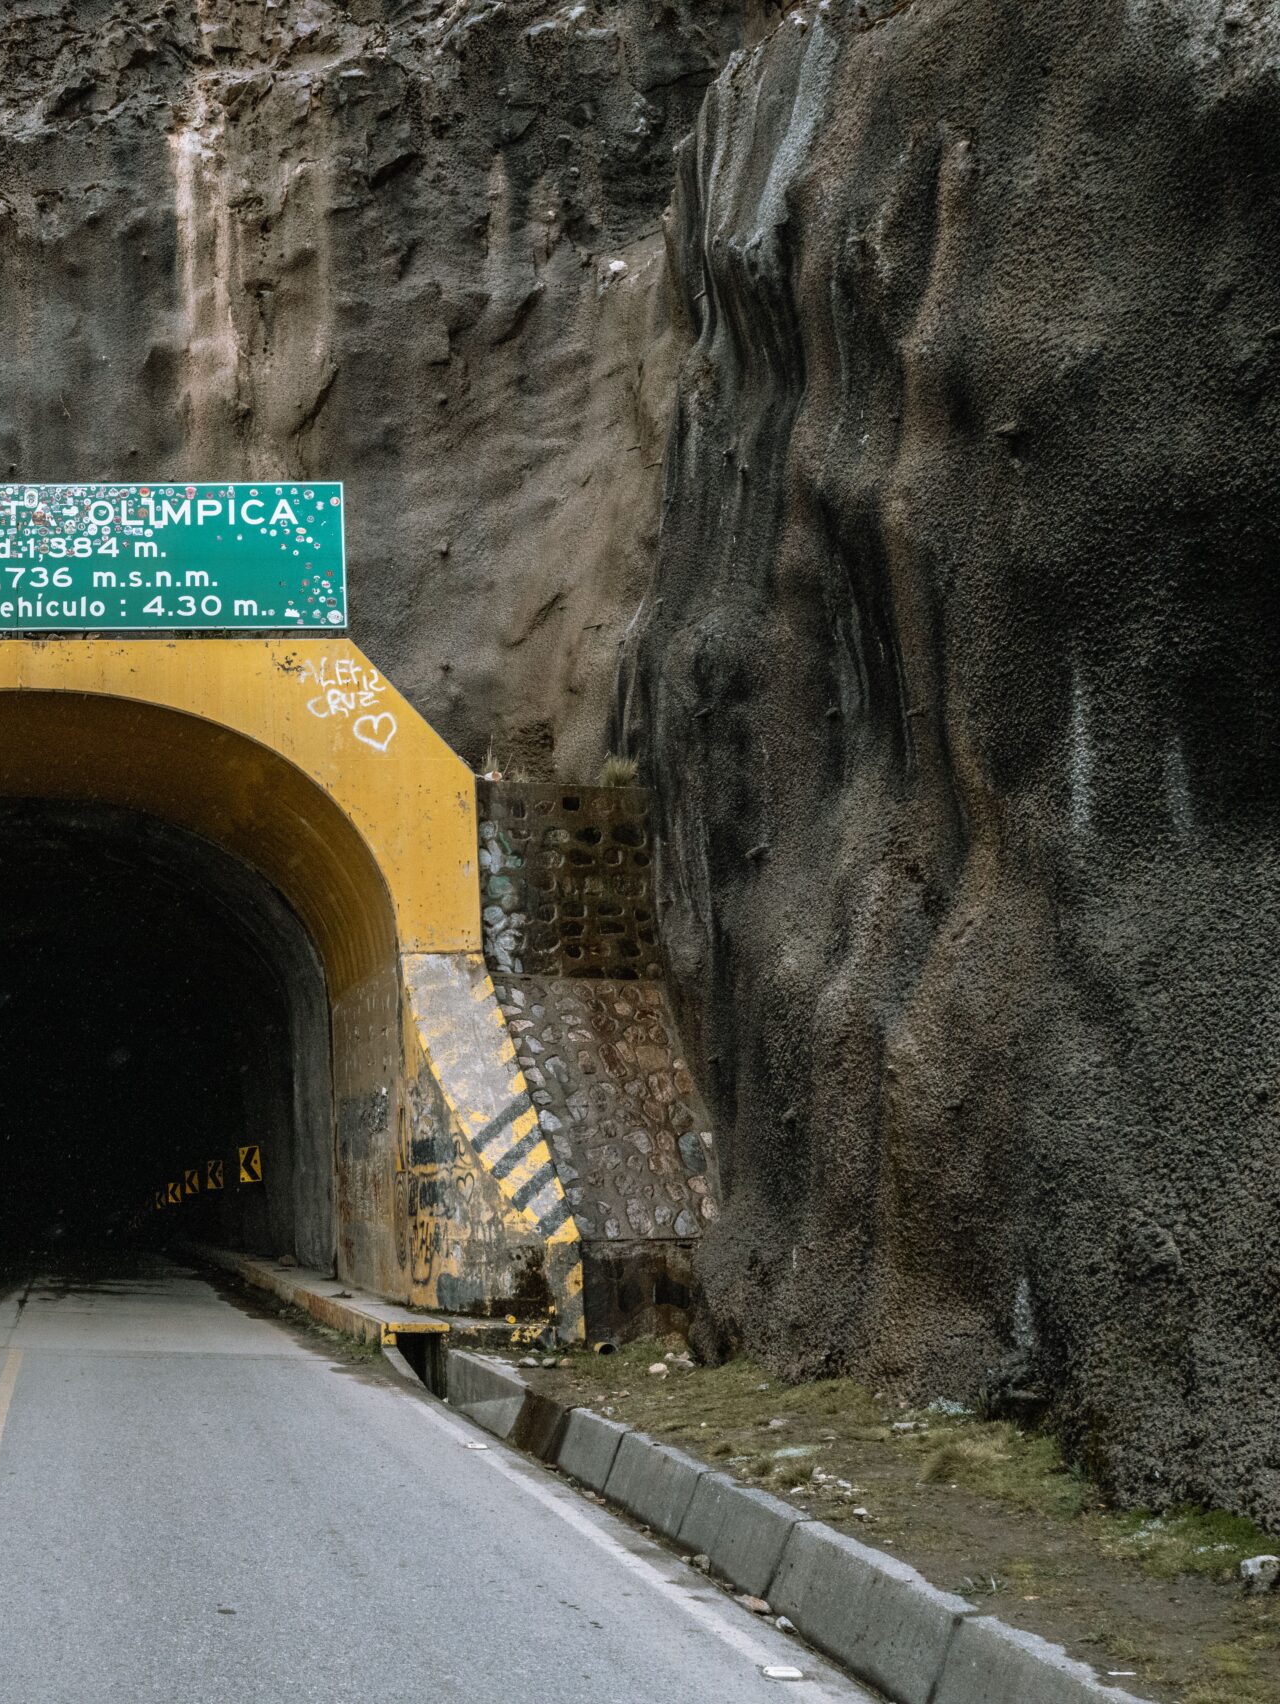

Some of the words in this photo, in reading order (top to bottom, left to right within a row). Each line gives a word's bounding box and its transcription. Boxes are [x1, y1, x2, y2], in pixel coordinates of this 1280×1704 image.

[134, 541, 167, 558] m.
[92, 570, 219, 588] m.s.n.m.
[142, 595, 222, 617] 4.30
[233, 598, 268, 617] m.
